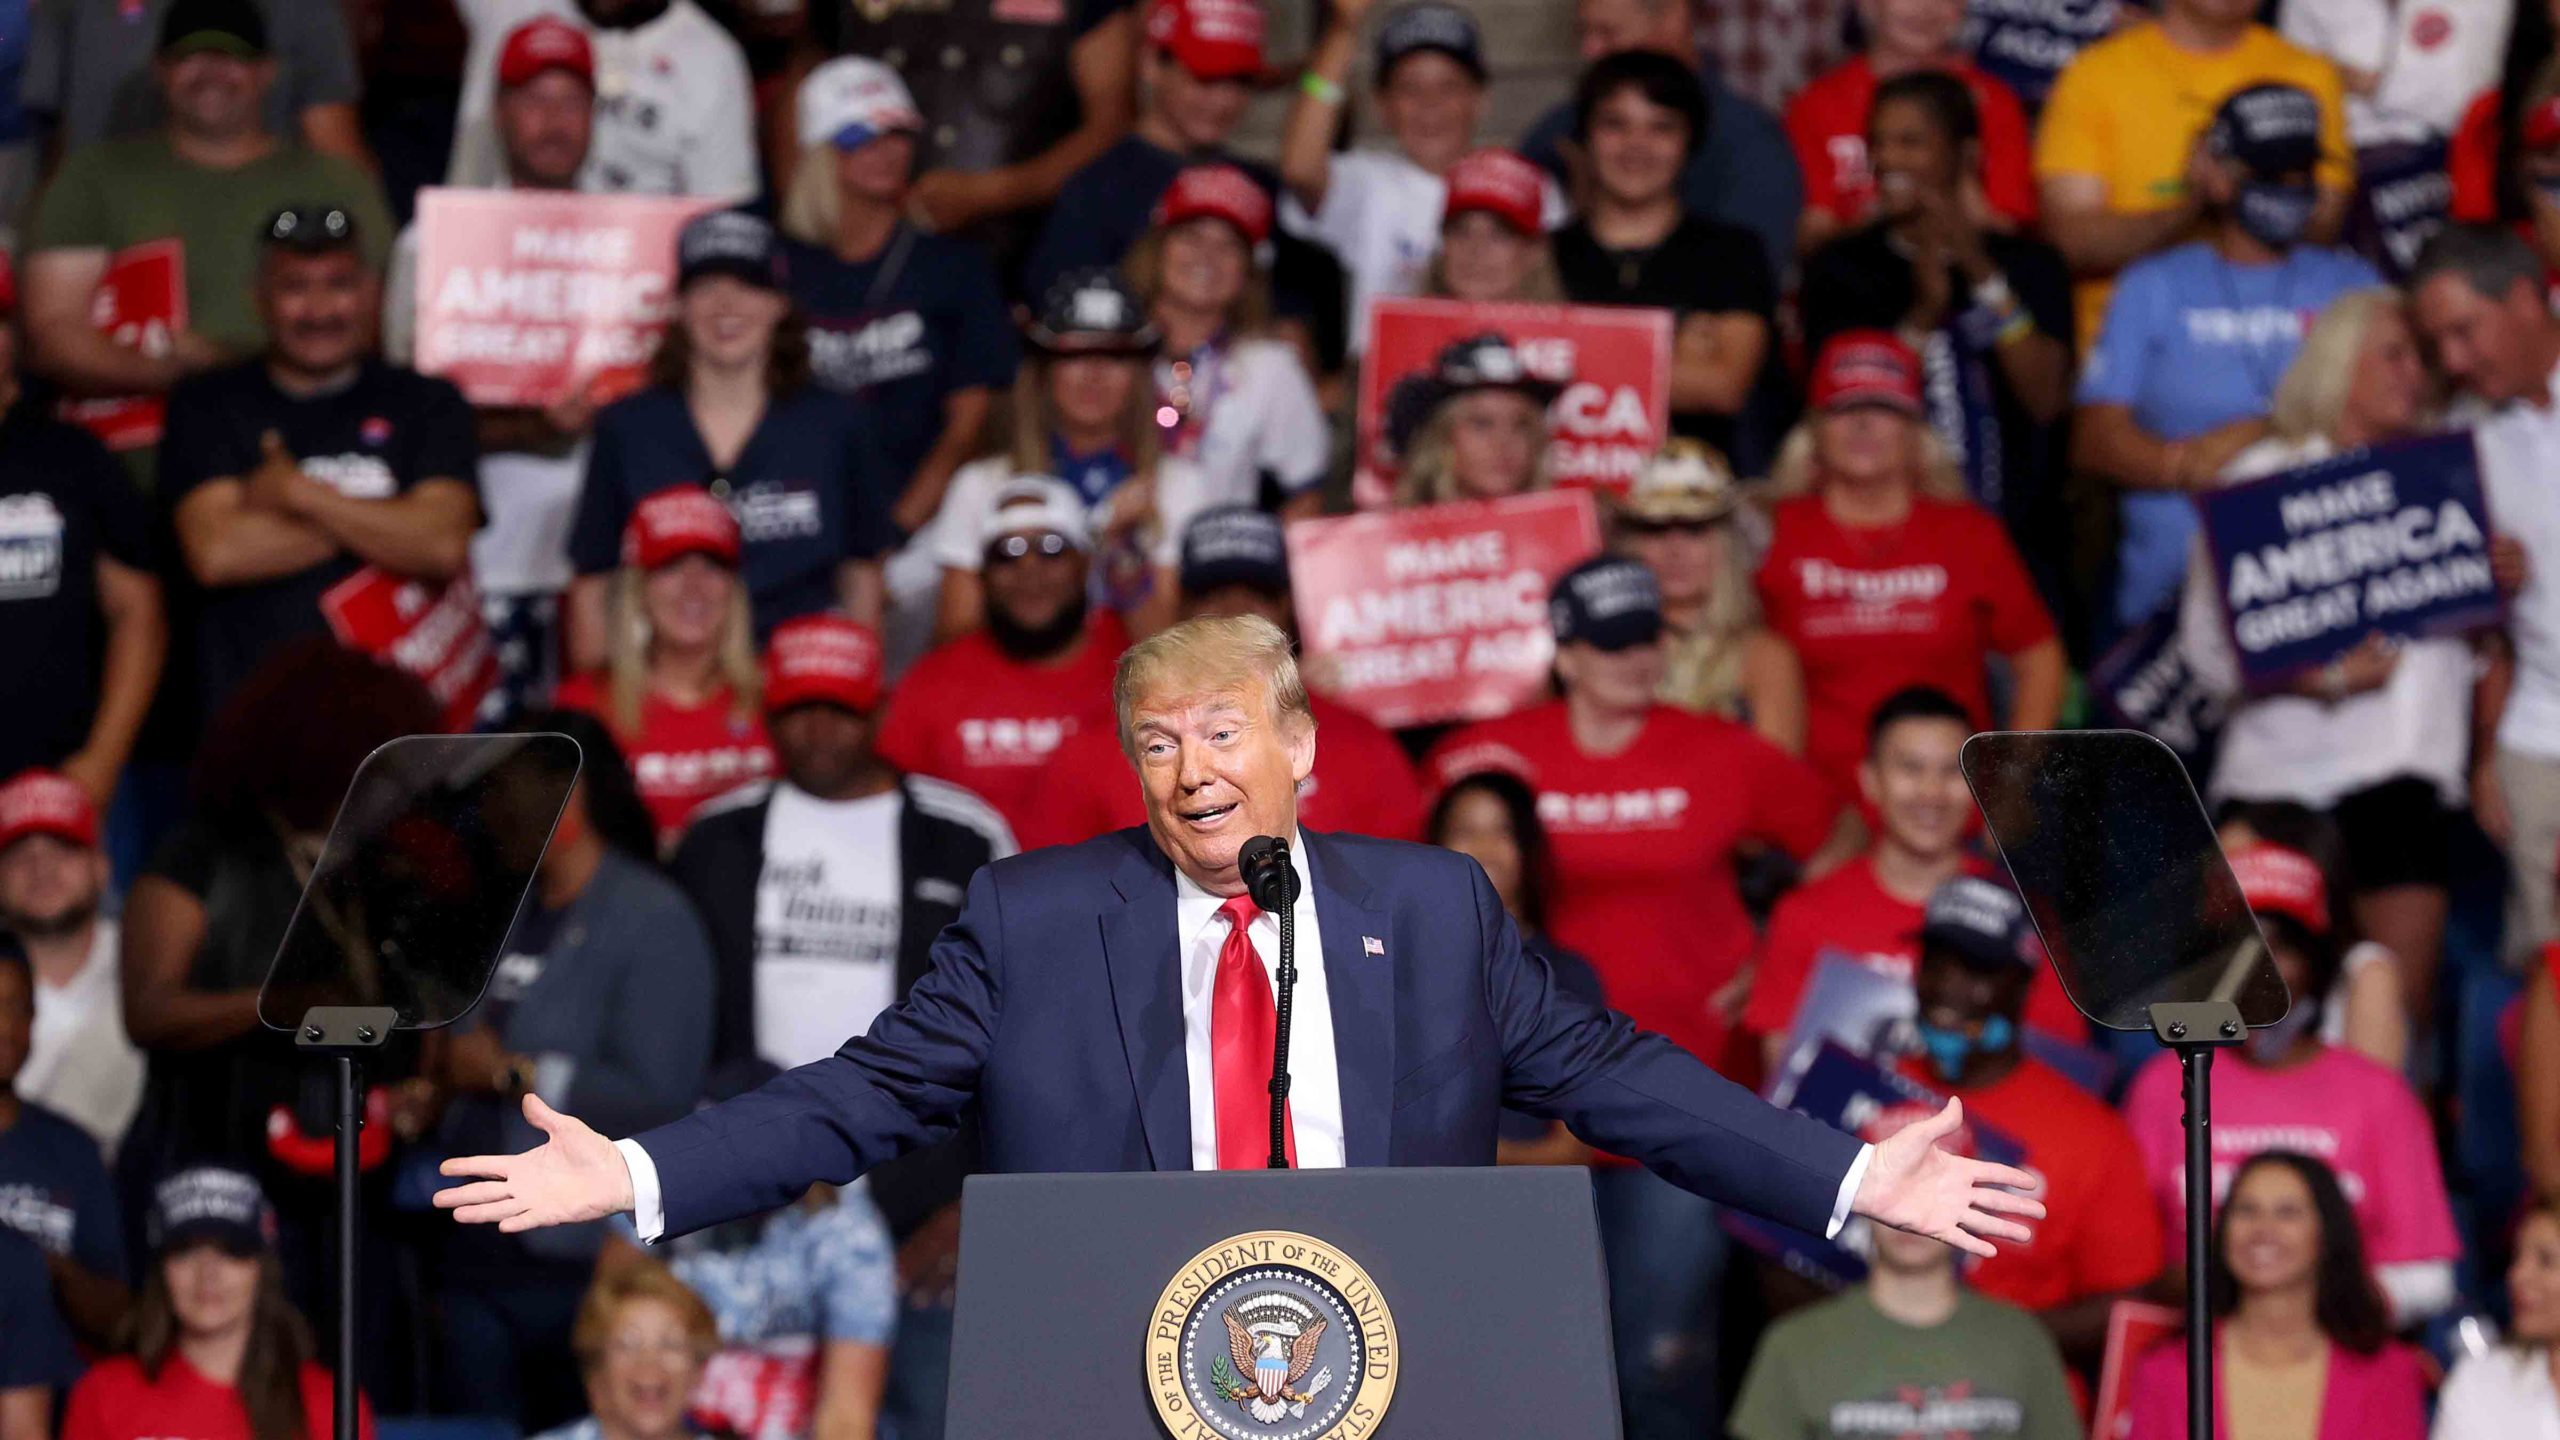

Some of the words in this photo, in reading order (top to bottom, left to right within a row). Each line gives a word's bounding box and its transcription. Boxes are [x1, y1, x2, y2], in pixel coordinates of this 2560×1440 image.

[513, 227, 633, 261] MAKE
[438, 266, 668, 321] AMERIC
[433, 323, 567, 362] GREAT
[1515, 337, 1577, 382] KE
[2279, 469, 2398, 536] MAKE
[1385, 530, 1504, 580] MAKE
[2229, 499, 2486, 611] AMERICA
[1318, 567, 1547, 650] AMERIC
[2235, 581, 2361, 652] GREAT
[2362, 552, 2495, 619] AGAIN
[957, 716, 1064, 755] TRU
[635, 746, 773, 785] RUMP
[1536, 786, 1690, 824] RUMP
[1156, 1240, 1275, 1342] PRESIDENT
[1282, 1244, 1306, 1260] OF
[1311, 1251, 1341, 1277] THE
[1344, 1276, 1390, 1380] UNITED
[1158, 1352, 1172, 1386] THE
[1164, 1391, 1183, 1412] OF
